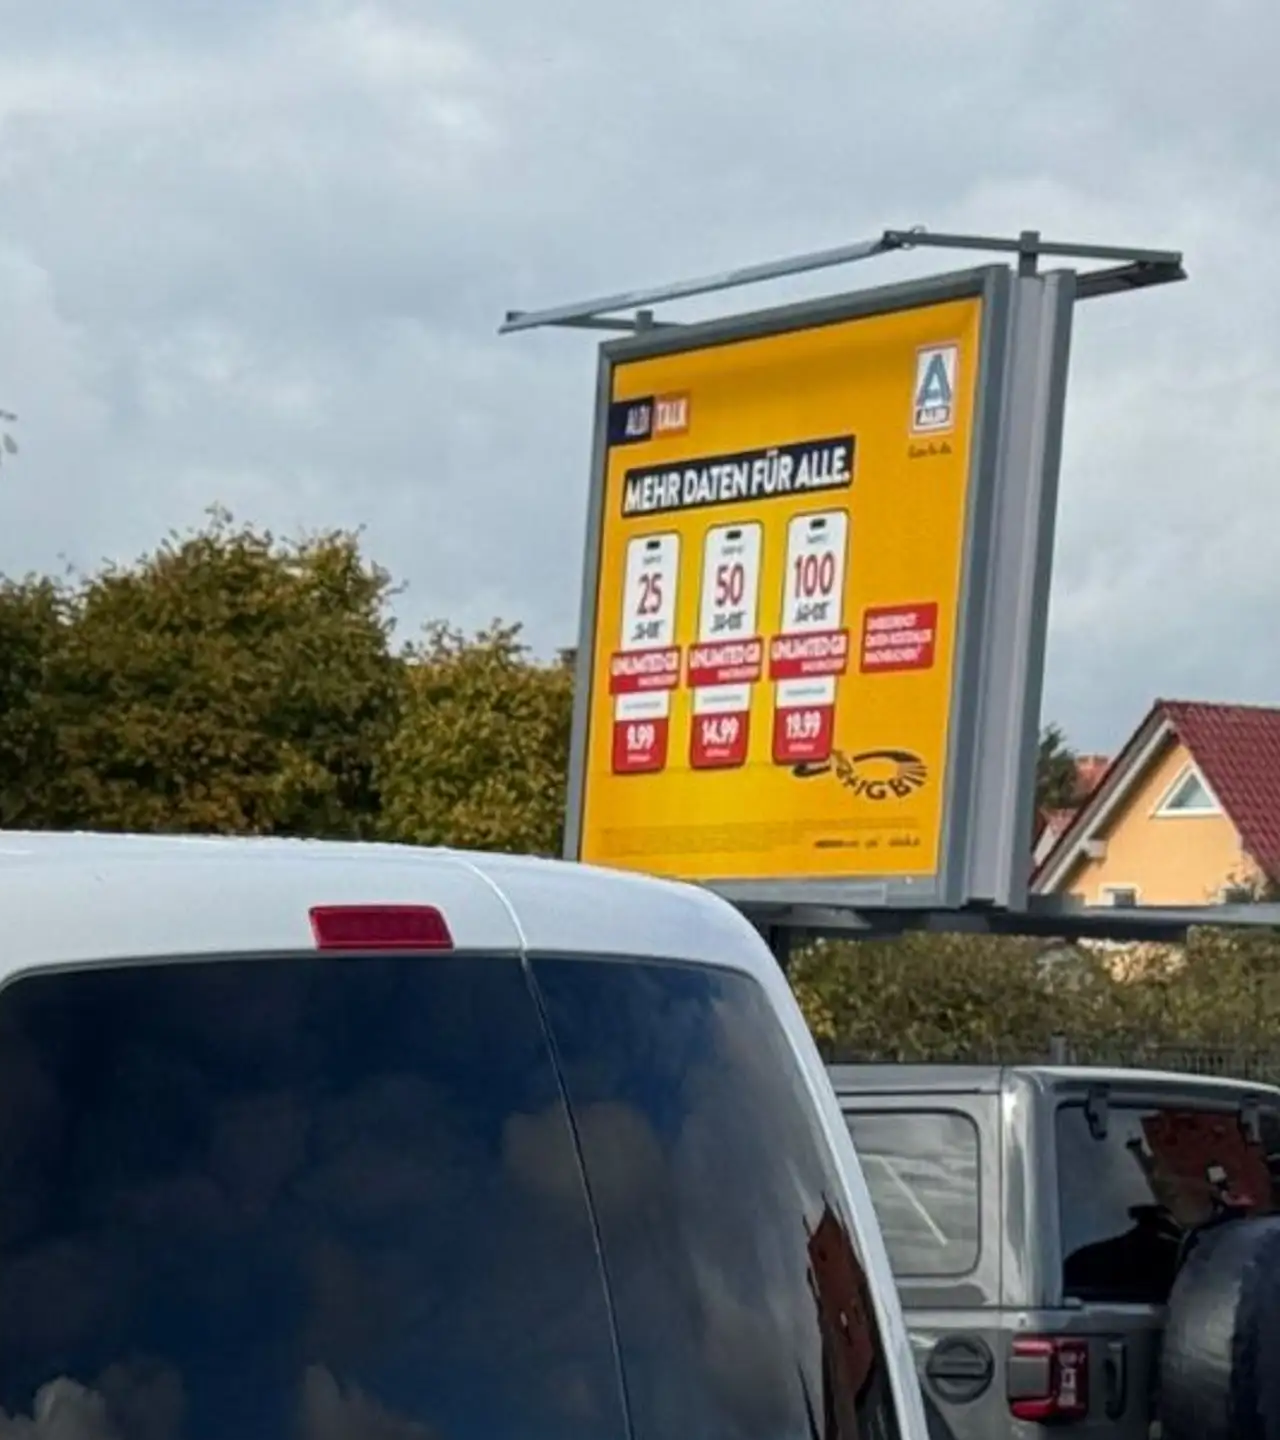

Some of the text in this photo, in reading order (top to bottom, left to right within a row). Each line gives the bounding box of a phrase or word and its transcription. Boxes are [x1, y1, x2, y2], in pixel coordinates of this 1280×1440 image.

[624, 446, 851, 514] MEHR DATEN FÜR ALLE.
[636, 571, 663, 616] 25
[715, 563, 744, 608] 50
[794, 551, 836, 599] 100
[702, 716, 739, 746] 14.99
[786, 710, 821, 739] 19.99
